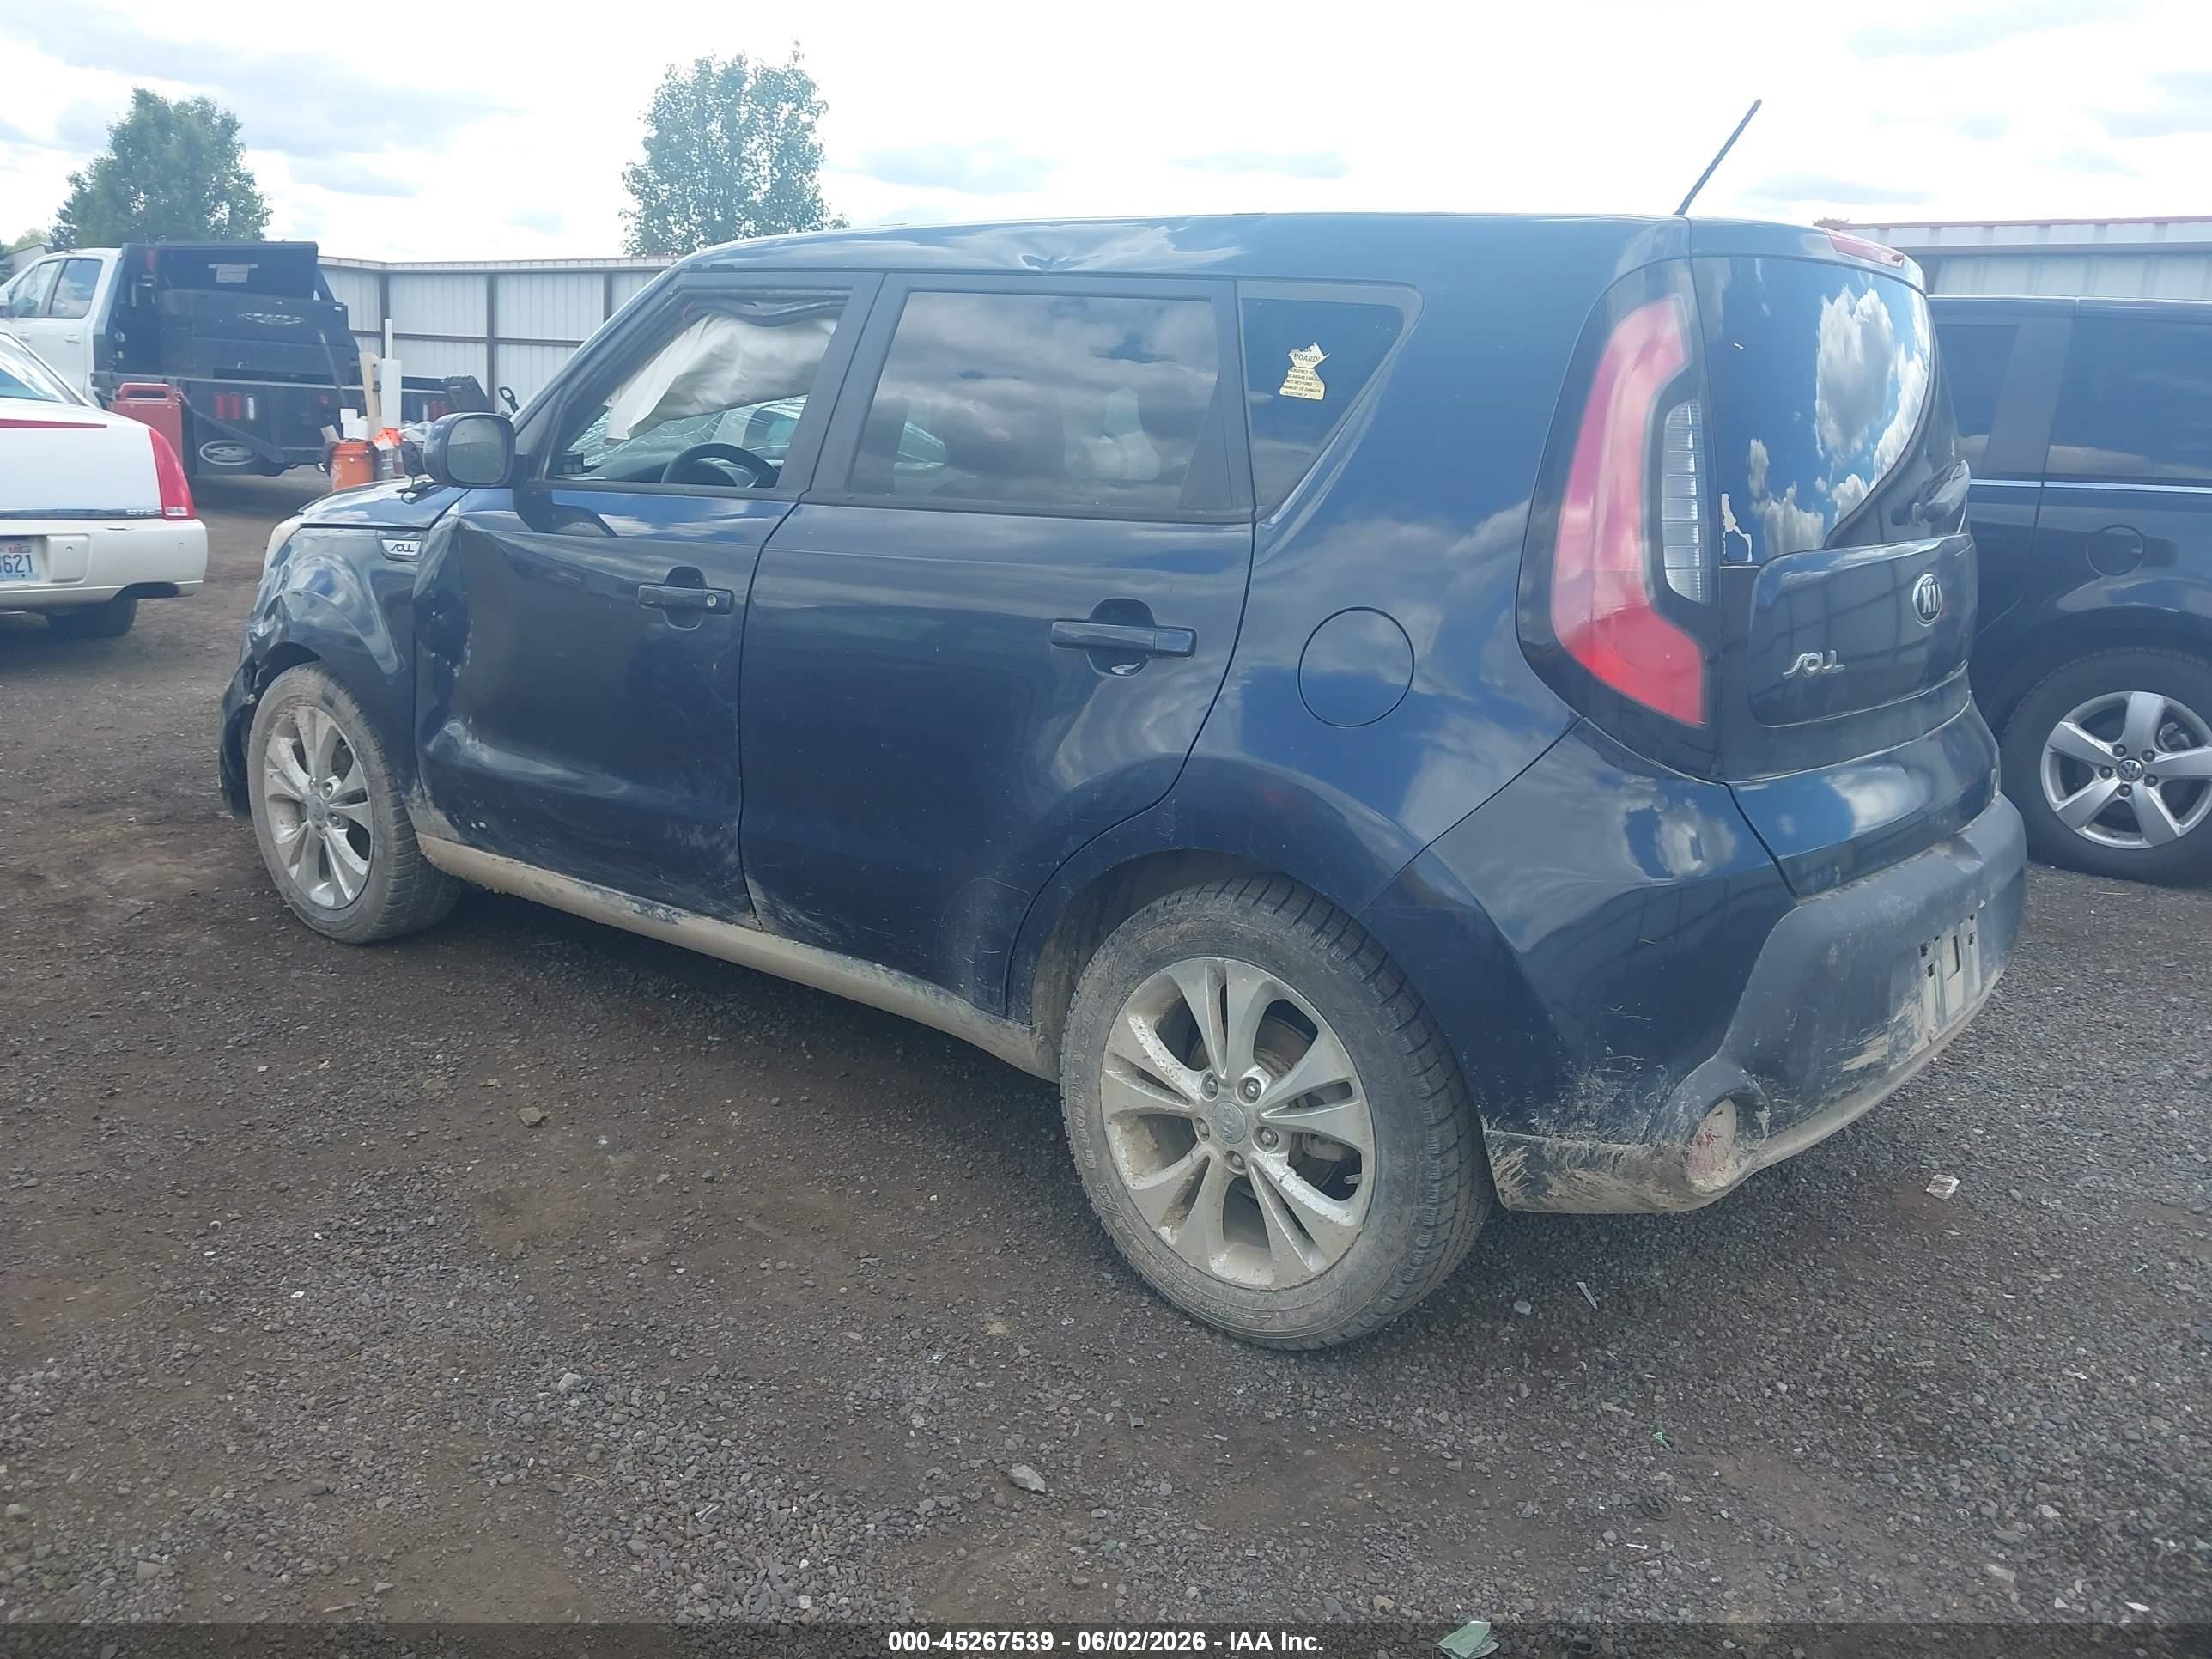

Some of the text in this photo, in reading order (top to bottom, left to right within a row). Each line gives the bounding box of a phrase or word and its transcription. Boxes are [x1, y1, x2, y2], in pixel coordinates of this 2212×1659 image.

[390, 544, 415, 552] SOUL
[0, 554, 33, 574] 621
[1782, 649, 1846, 680] SOUL
